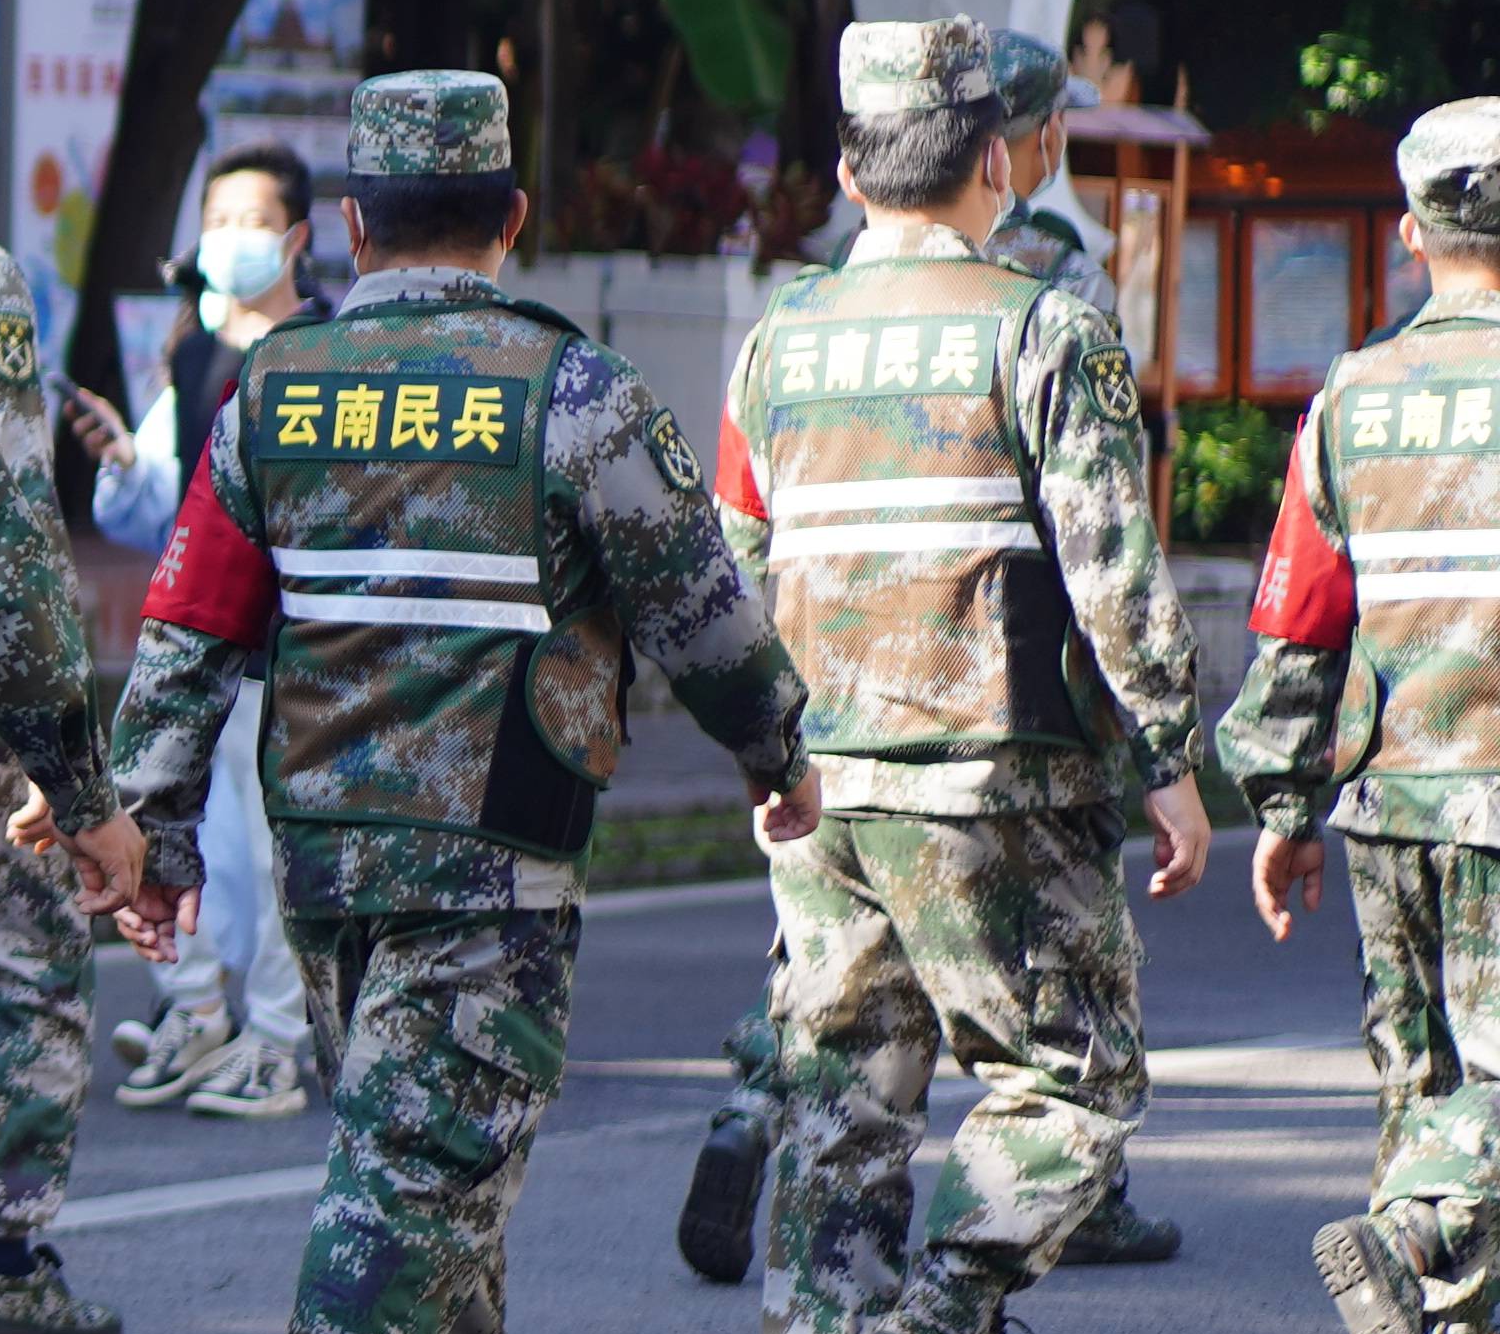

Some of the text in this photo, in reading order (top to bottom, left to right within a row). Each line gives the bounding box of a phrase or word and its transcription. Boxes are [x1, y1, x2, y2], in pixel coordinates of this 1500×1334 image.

[779, 322, 979, 394] 云南民兵
[276, 383, 506, 455] 云南民兵
